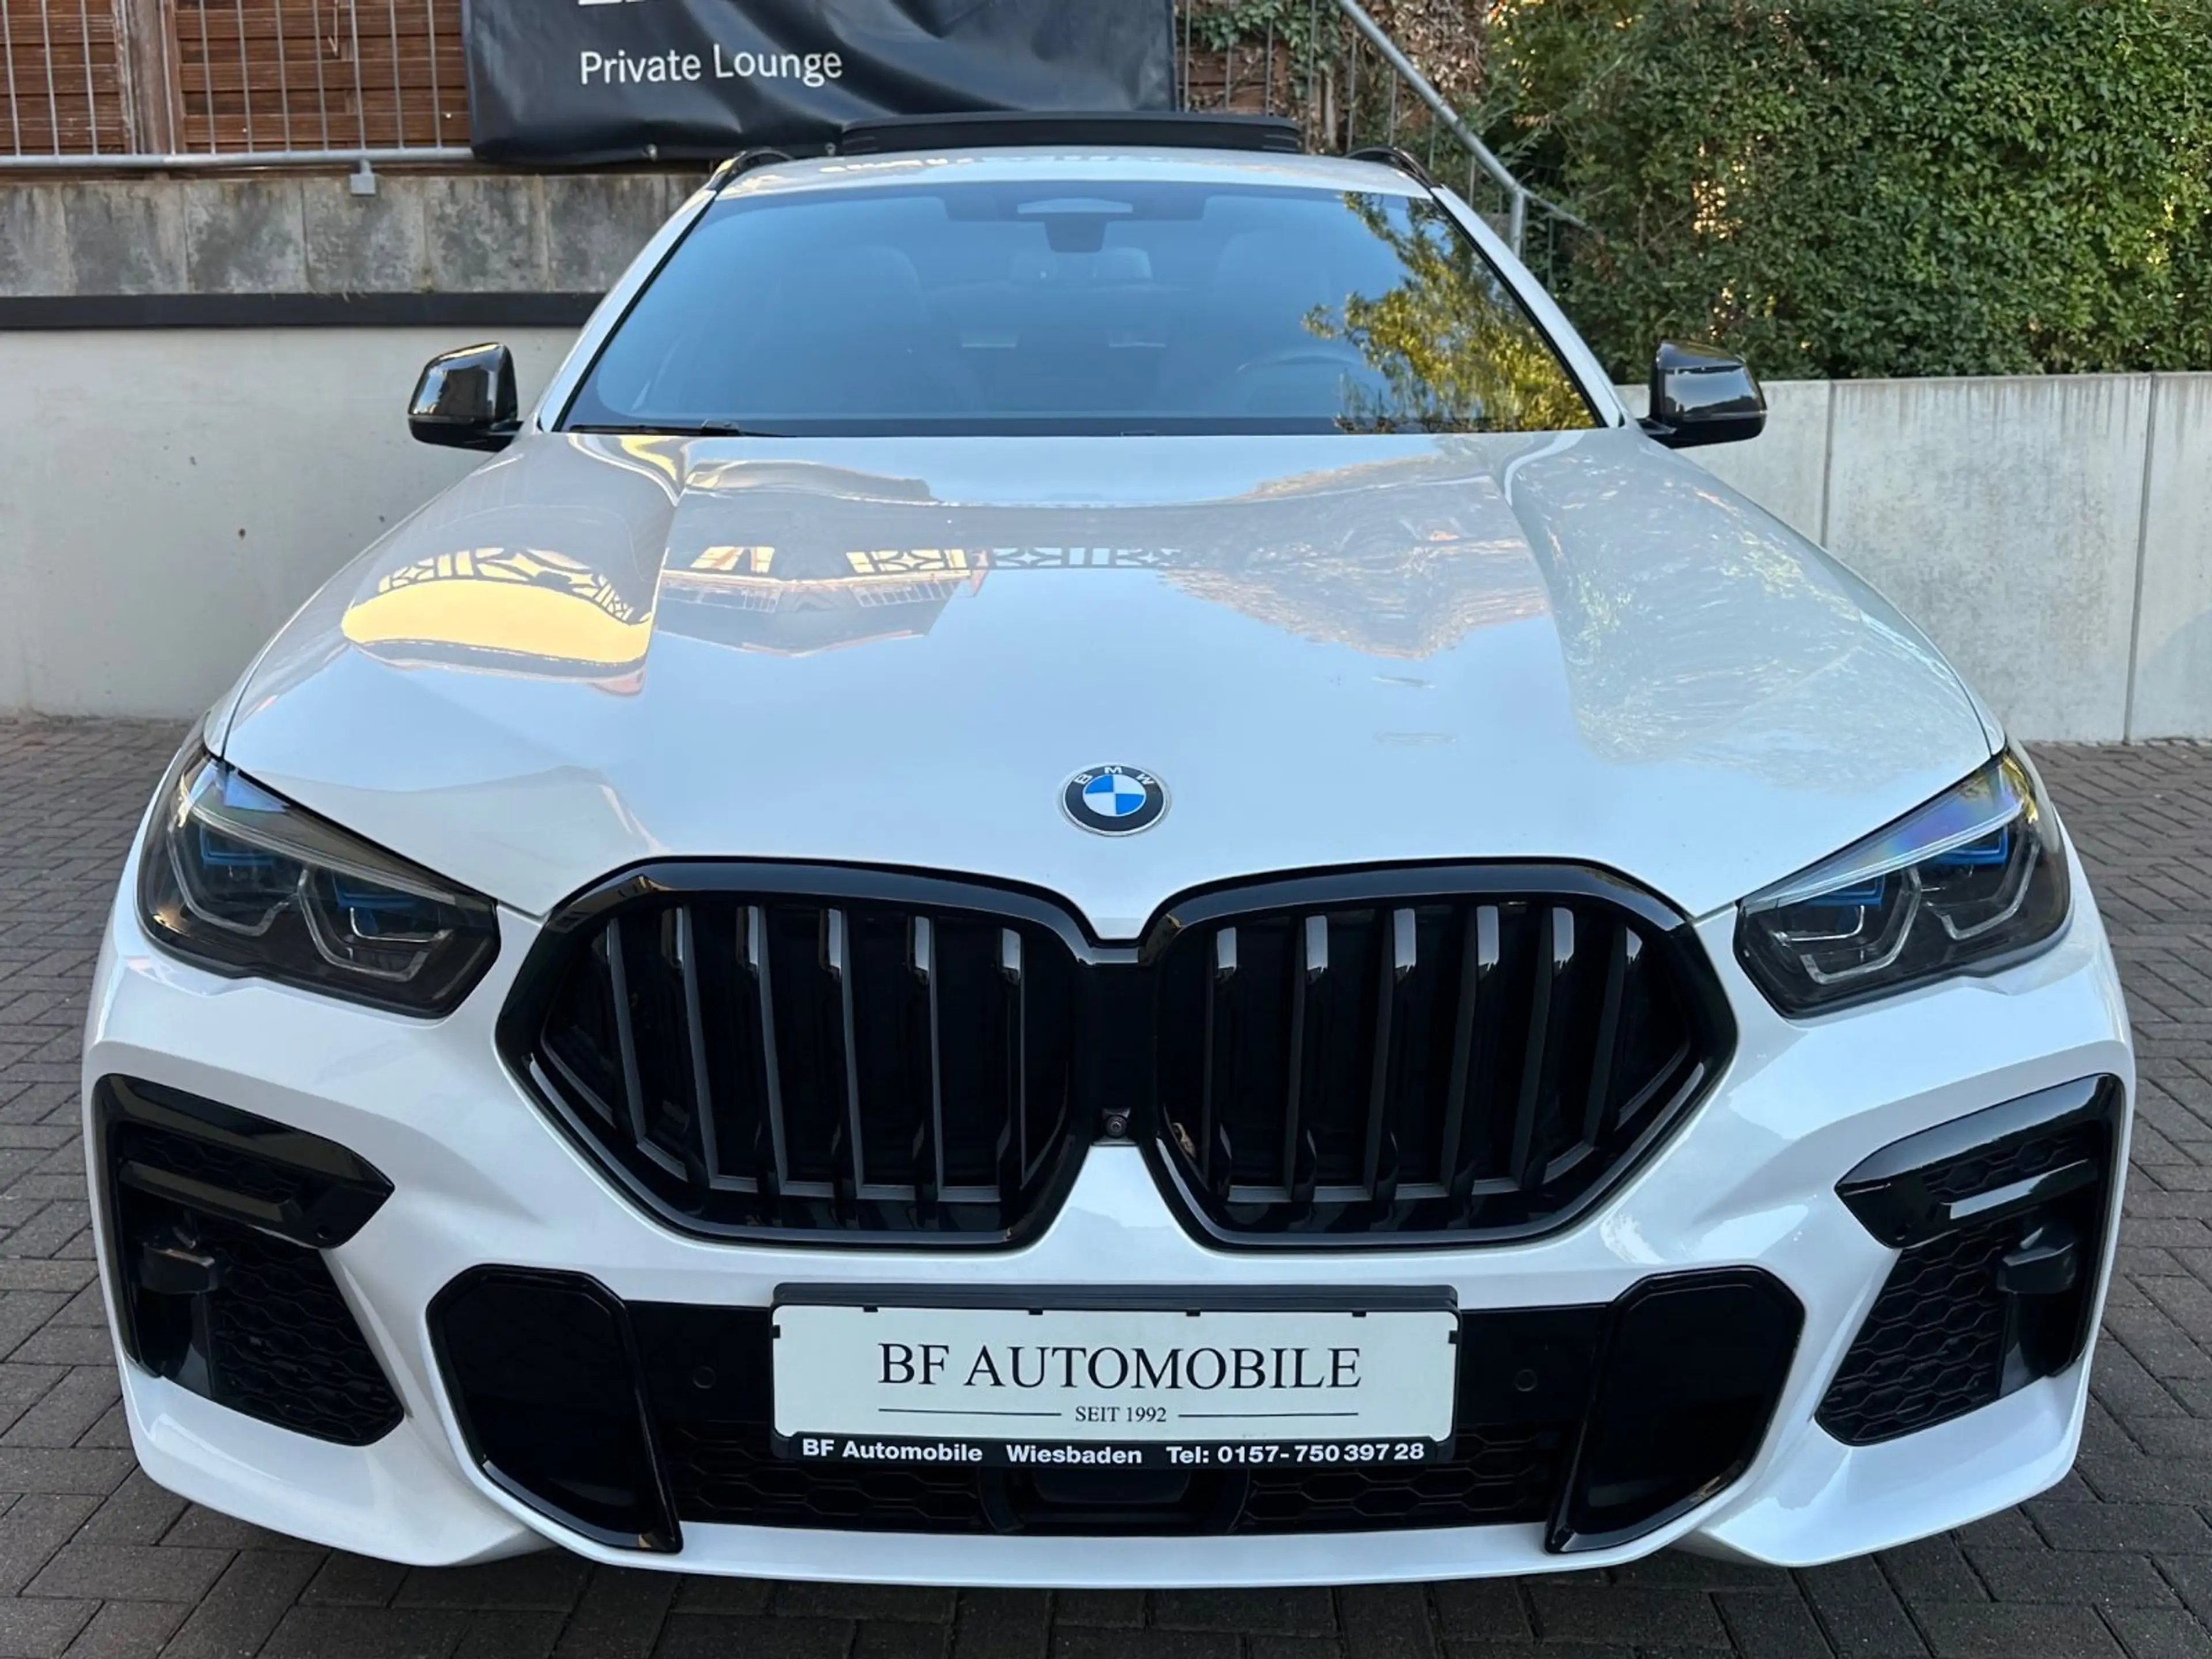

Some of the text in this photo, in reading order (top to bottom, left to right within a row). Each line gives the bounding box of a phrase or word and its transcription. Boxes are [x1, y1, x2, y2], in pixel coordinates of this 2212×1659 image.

[580, 43, 843, 88] Private Lounge
[1074, 766, 1155, 785] BMW
[877, 1343, 1362, 1390] BF AUTOMOBILE
[1075, 1406, 1167, 1423] SEIT 1992
[802, 1438, 835, 1457] BF
[842, 1440, 983, 1462] Automobile
[1006, 1444, 1142, 1464] Wiesbaden
[1165, 1446, 1210, 1464] Tel:
